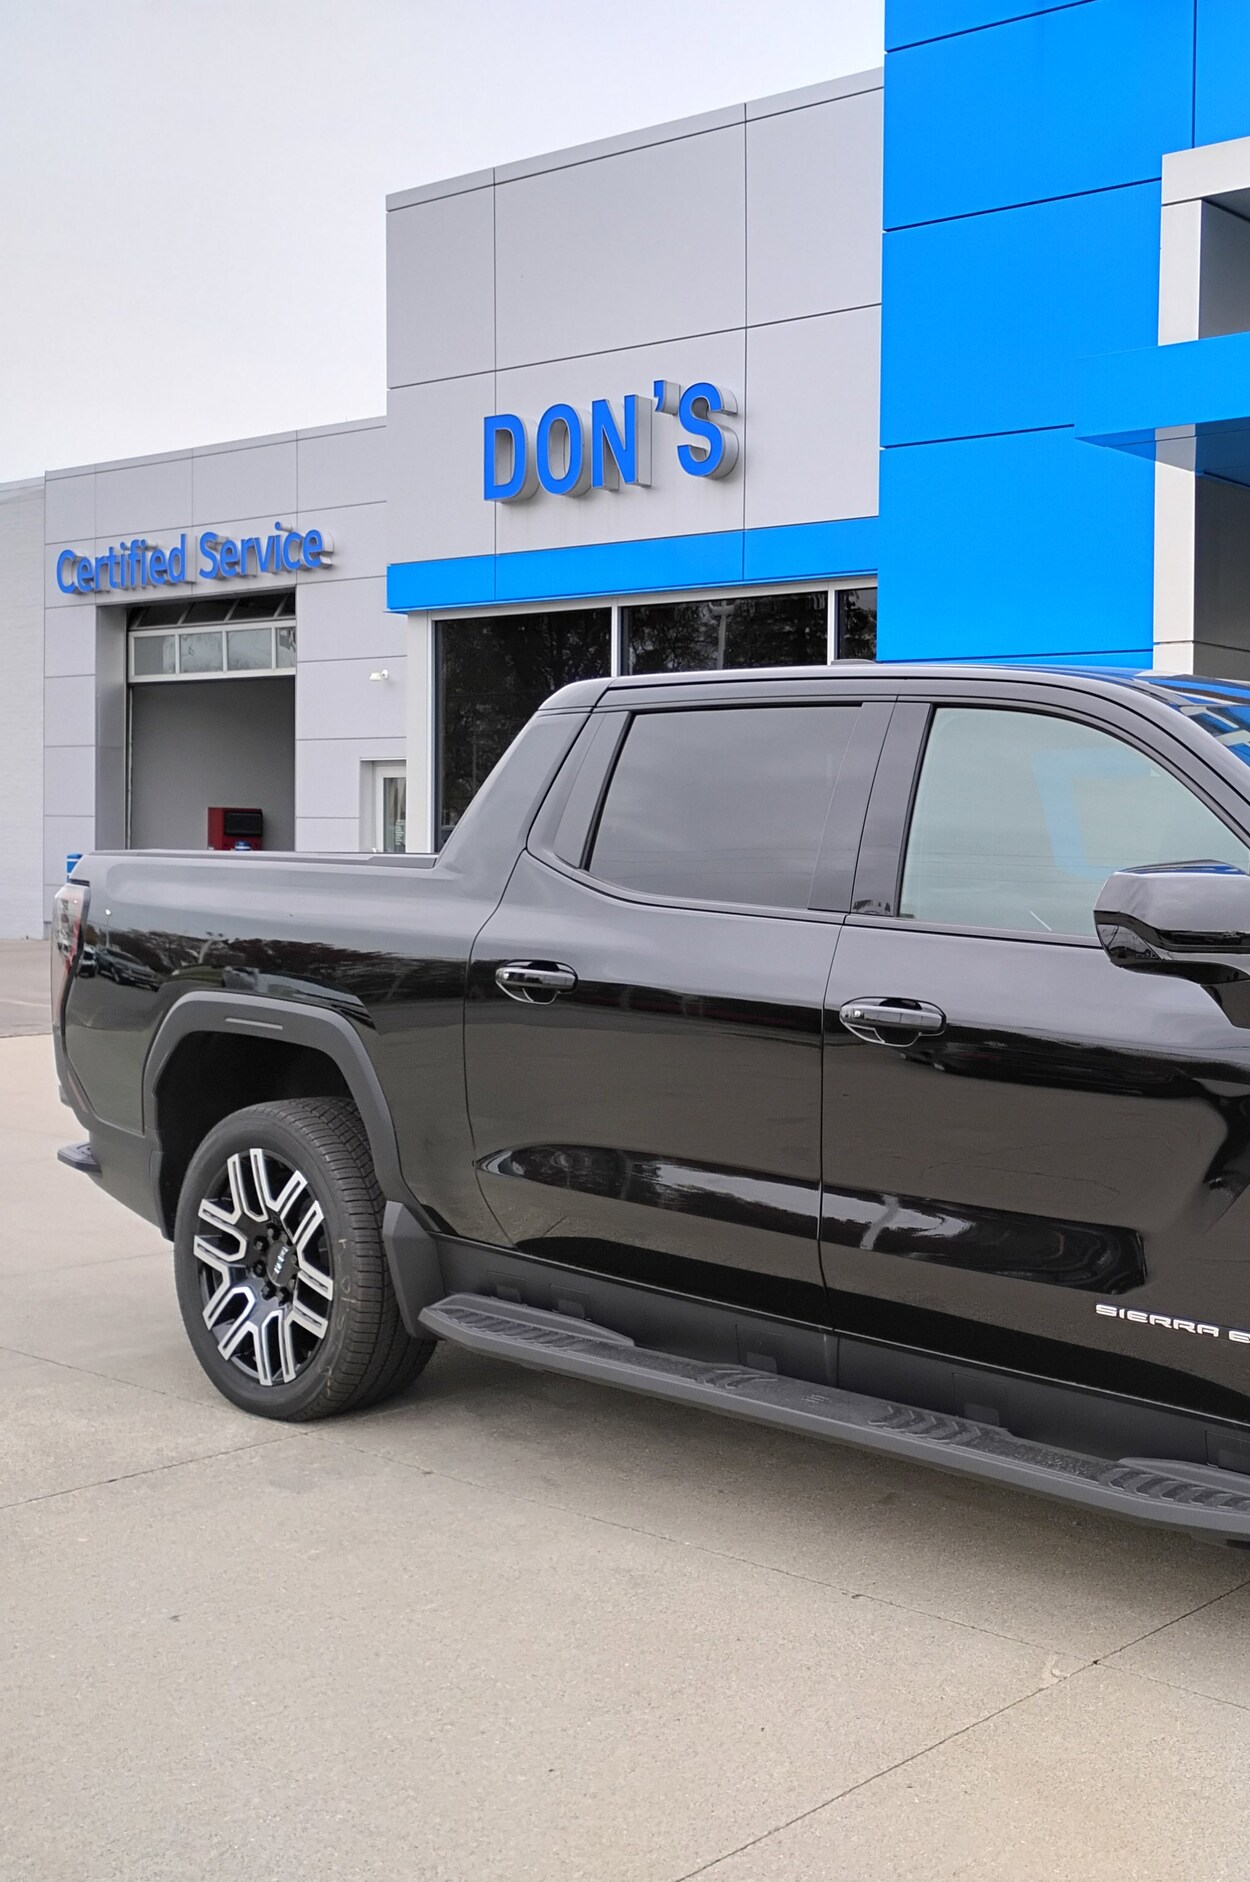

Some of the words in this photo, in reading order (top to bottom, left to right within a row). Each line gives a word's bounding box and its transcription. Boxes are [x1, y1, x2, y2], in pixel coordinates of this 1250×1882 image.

[484, 379, 732, 501] DON'S
[56, 533, 188, 594] Certified
[199, 521, 328, 580] Service
[1095, 1304, 1220, 1338] SIERRA
